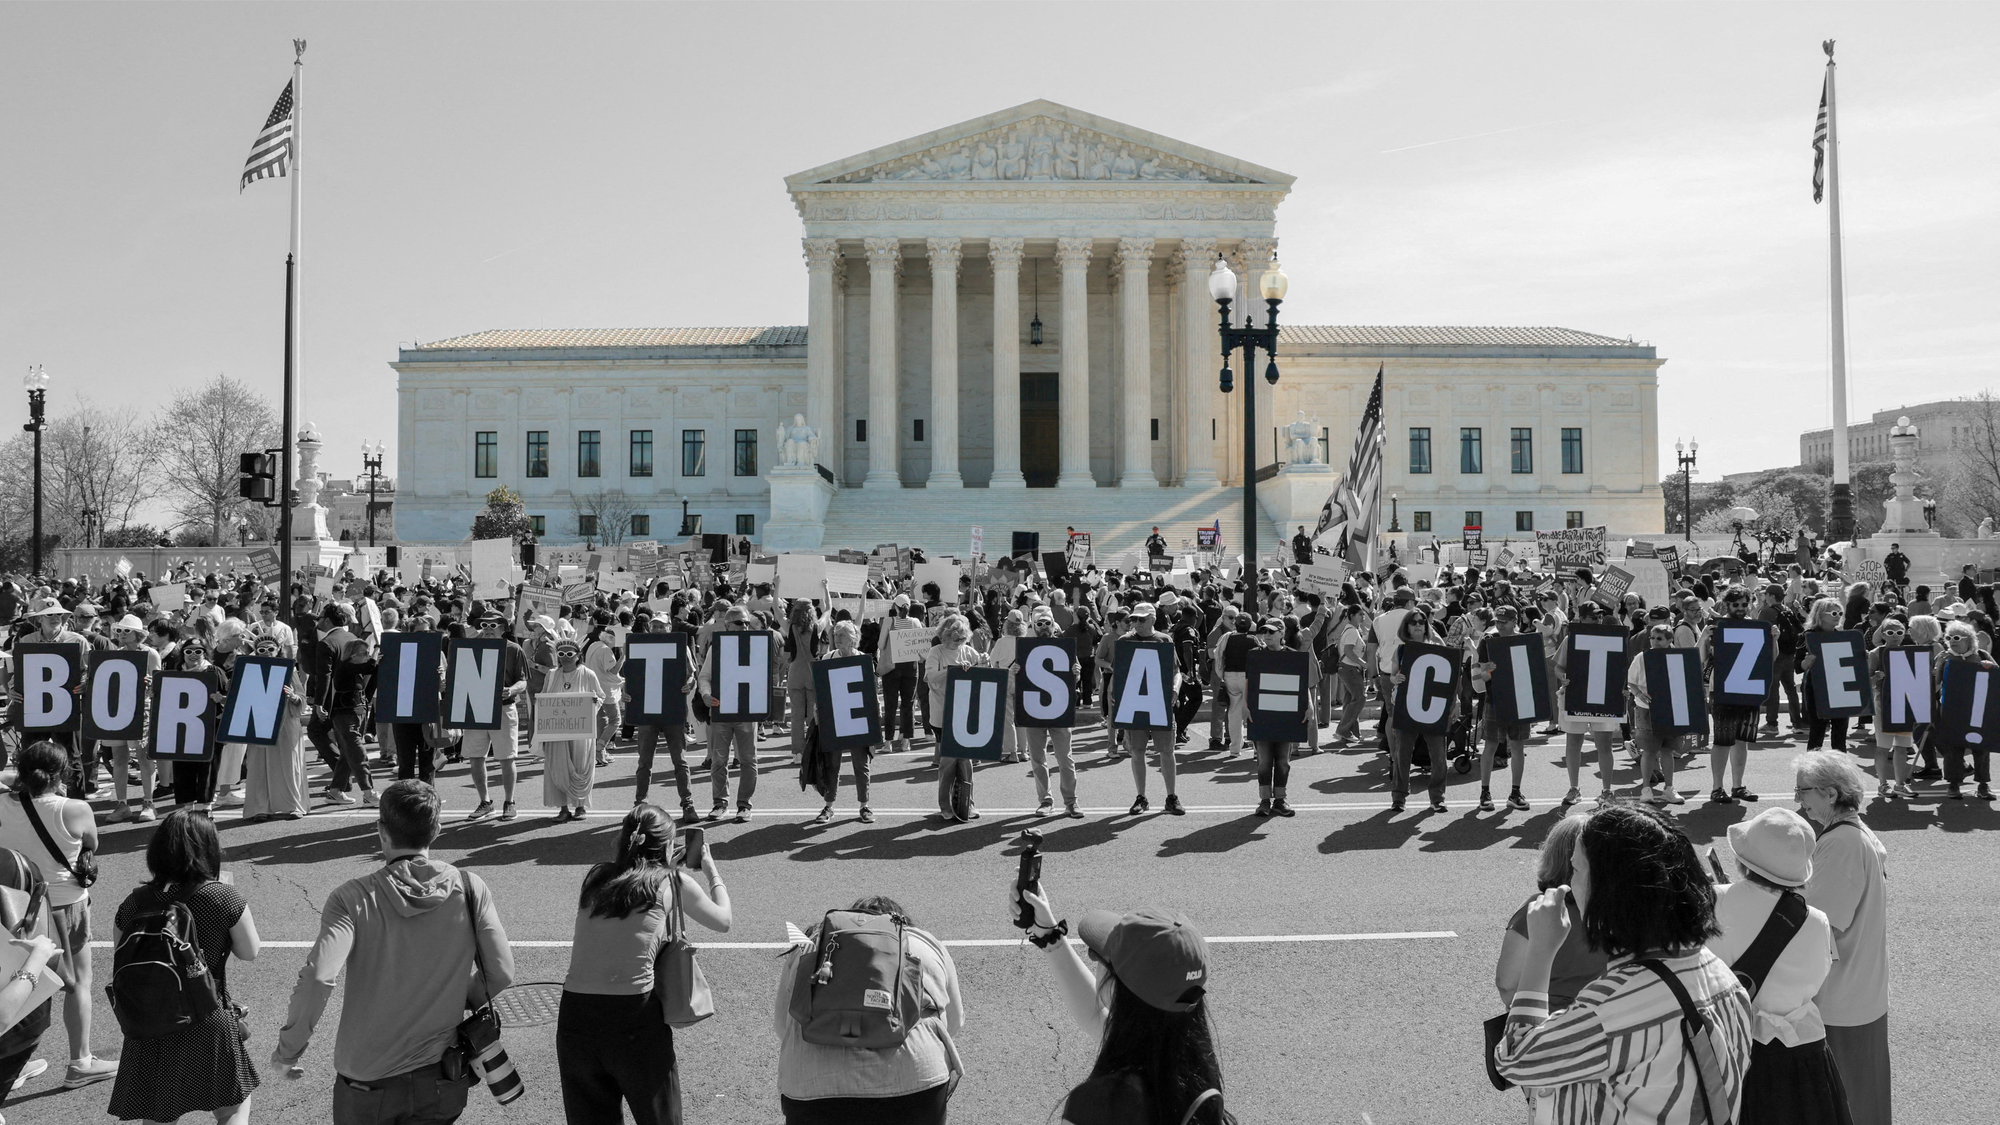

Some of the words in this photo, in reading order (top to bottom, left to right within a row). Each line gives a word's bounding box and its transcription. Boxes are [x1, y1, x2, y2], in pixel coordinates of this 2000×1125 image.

[1859, 560, 1882, 572] STOP
[1632, 566, 1662, 583] ICE
[1856, 572, 1885, 581] RACISM
[1604, 573, 1629, 590] BIRTH
[1600, 581, 1625, 598] RIGHT
[1636, 585, 1663, 599] OUT
[904, 638, 932, 646] SIEMPR
[538, 717, 586, 730] BIRTHRIGHT
[1186, 970, 1202, 980] ACLU
